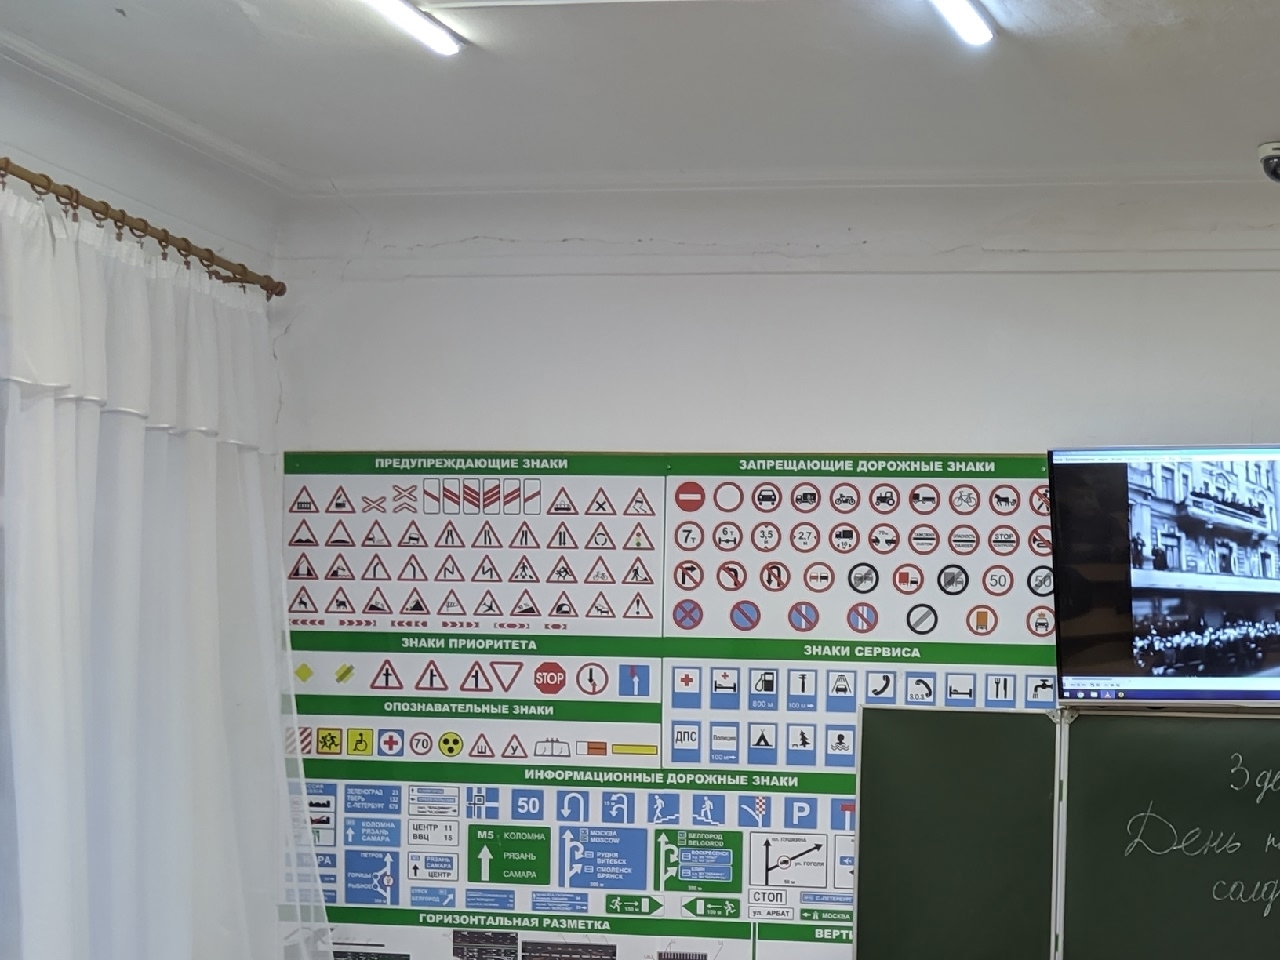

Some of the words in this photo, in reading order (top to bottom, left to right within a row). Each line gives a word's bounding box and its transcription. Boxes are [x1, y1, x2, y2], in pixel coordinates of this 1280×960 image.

[375, 458, 518, 470] ПРЕДУПРЕЖДАЮЩИЕ
[522, 458, 568, 470] ЗНАКИ
[739, 459, 853, 472] ЗАПРЕЩАЮЩИЕ
[856, 460, 943, 473] ДОРОЖНЫЕ
[946, 461, 996, 473] ЗНАКИ
[989, 574, 1007, 588] 50
[401, 637, 445, 649] ЗНАКИ
[448, 638, 537, 650] ПРИОРИТЕТА
[803, 644, 850, 656] ЗНАКИ
[853, 645, 921, 658] СЕРВИСА
[535, 672, 565, 685] STOP
[384, 702, 509, 715] ОПОЗНАВАТЕЛЬНЫЕ
[512, 705, 554, 715] ЗНАКИ
[414, 737, 429, 749] 70
[675, 730, 697, 743] ДПС
[524, 769, 663, 783] ИНФОРМАЦИОННЫЕ
[666, 773, 748, 786] ДОРОЖНЫЕ
[752, 775, 798, 787] ЗНАКИ
[1230, 752, 1250, 791] 3
[517, 797, 540, 814] 50
[792, 802, 811, 825] P
[412, 823, 439, 832] ЦЕНТР
[1124, 800, 1242, 857] День
[412, 833, 430, 841] ВВЦ
[503, 832, 546, 840] КОЛОМНА
[503, 852, 537, 860] РЯЗАНЬ
[428, 871, 451, 879] ЦЕНТР
[753, 892, 783, 903] СТОП
[419, 913, 538, 928] ГОРИЗОНТАЛЬНАЯ
[542, 917, 611, 931] РАЗМЕТКА
